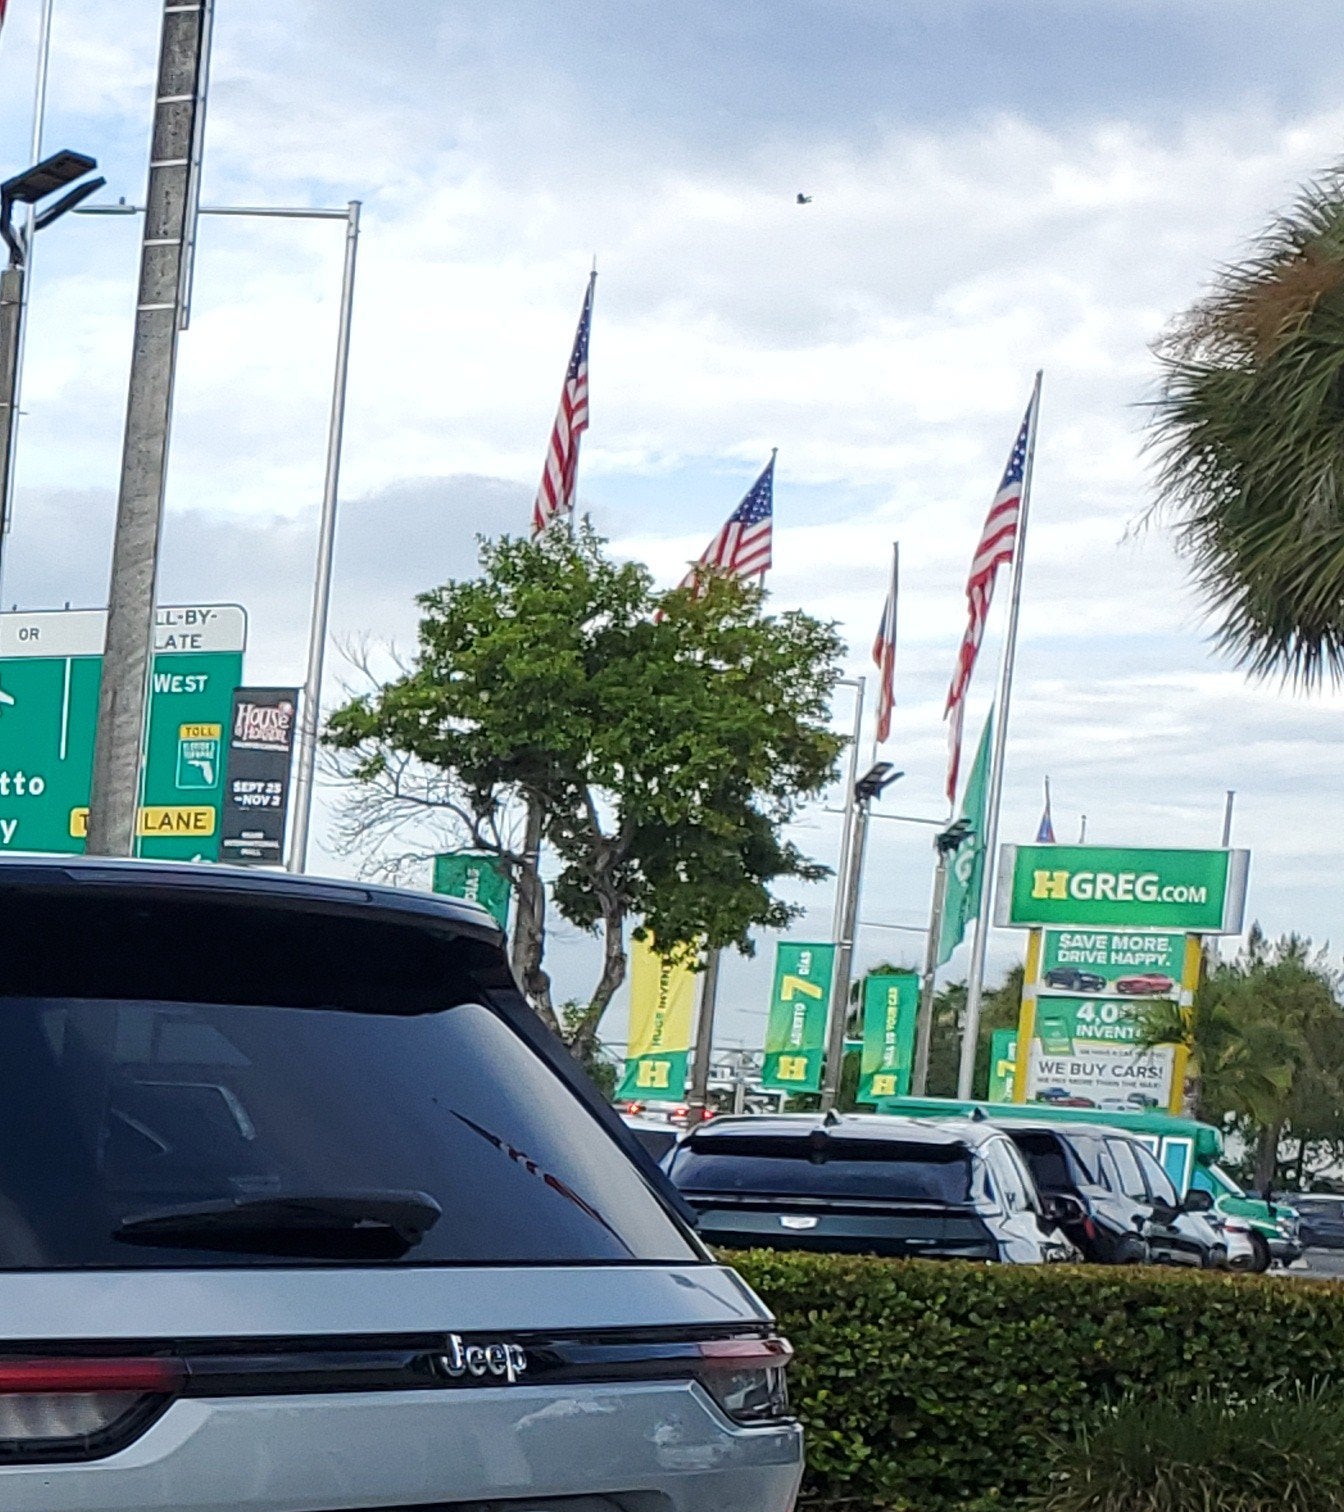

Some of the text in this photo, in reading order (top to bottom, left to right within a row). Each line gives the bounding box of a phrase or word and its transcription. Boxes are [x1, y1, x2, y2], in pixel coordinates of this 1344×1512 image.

[155, 609, 218, 625] LL-BY-
[18, 628, 40, 642] OR
[154, 634, 202, 649] LATE
[154, 673, 208, 693] WEST
[185, 726, 215, 737] TOLL
[233, 780, 265, 793] SEPT
[144, 812, 208, 830] LANE
[1059, 932, 1173, 952] SAVE MORE.
[1058, 950, 1171, 966] DRIVE HAPPY.
[781, 975, 823, 1000] 7
[1038, 1061, 1164, 1079] WE BUY CARS!
[441, 1333, 527, 1383] Jeep
